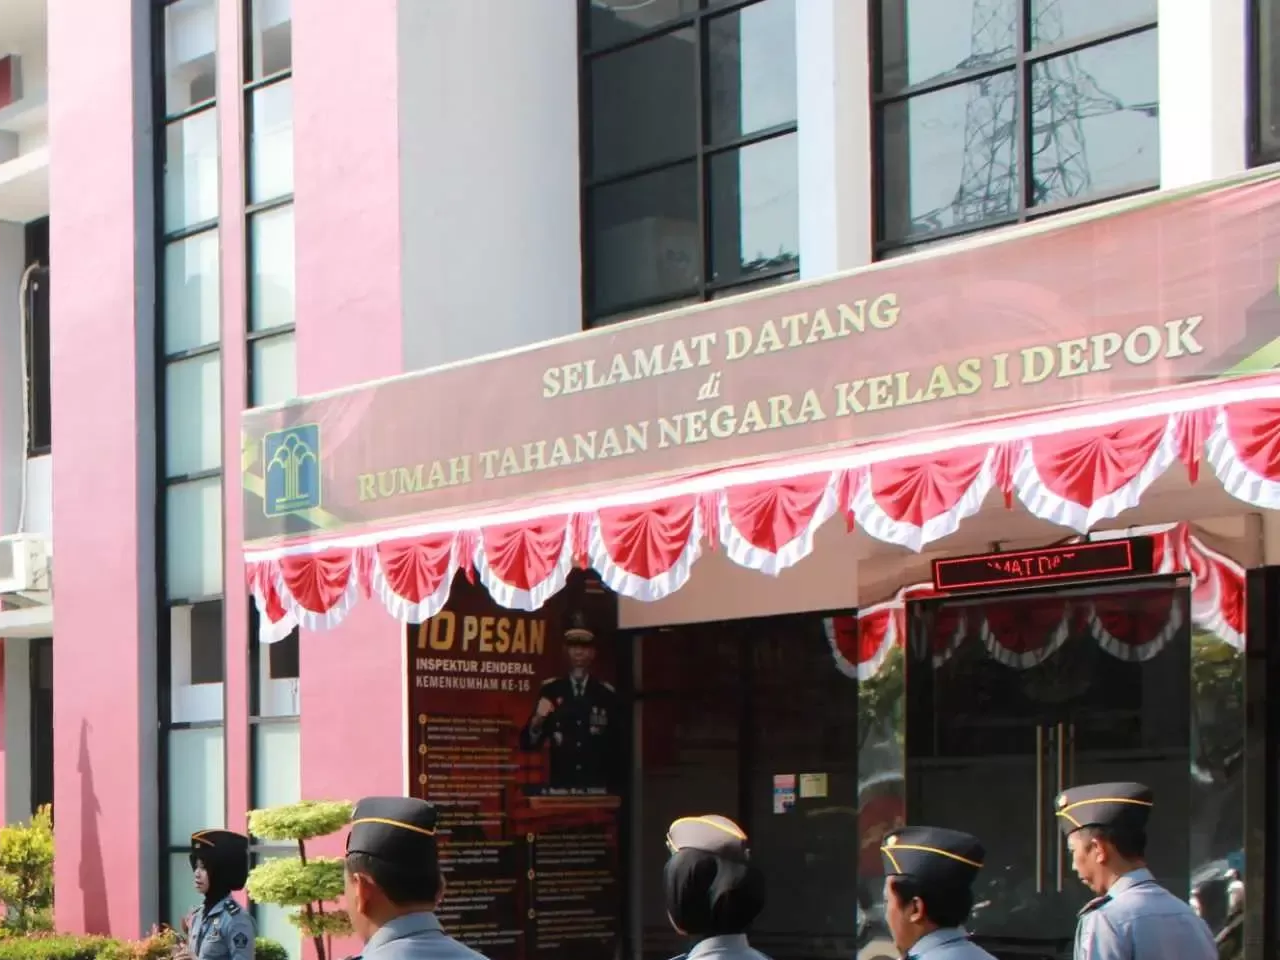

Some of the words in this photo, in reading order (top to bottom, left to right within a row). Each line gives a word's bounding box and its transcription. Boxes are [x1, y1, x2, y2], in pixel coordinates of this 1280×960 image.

[542, 331, 718, 399] SELAMAT
[724, 291, 902, 361] DATANG
[696, 370, 722, 401] di
[357, 453, 472, 501] RUMAH
[479, 420, 650, 480] TAHANAN
[657, 387, 825, 449] NEGARA
[835, 357, 983, 416] KELAS
[992, 352, 1011, 389] I
[1020, 314, 1205, 386] DEPOK
[417, 610, 456, 650] 10
[462, 615, 546, 654] PESAN
[416, 657, 478, 673] INSPEKTUR
[480, 661, 536, 675] JENDERAL
[416, 675, 499, 691] KEMENKUMHAM
